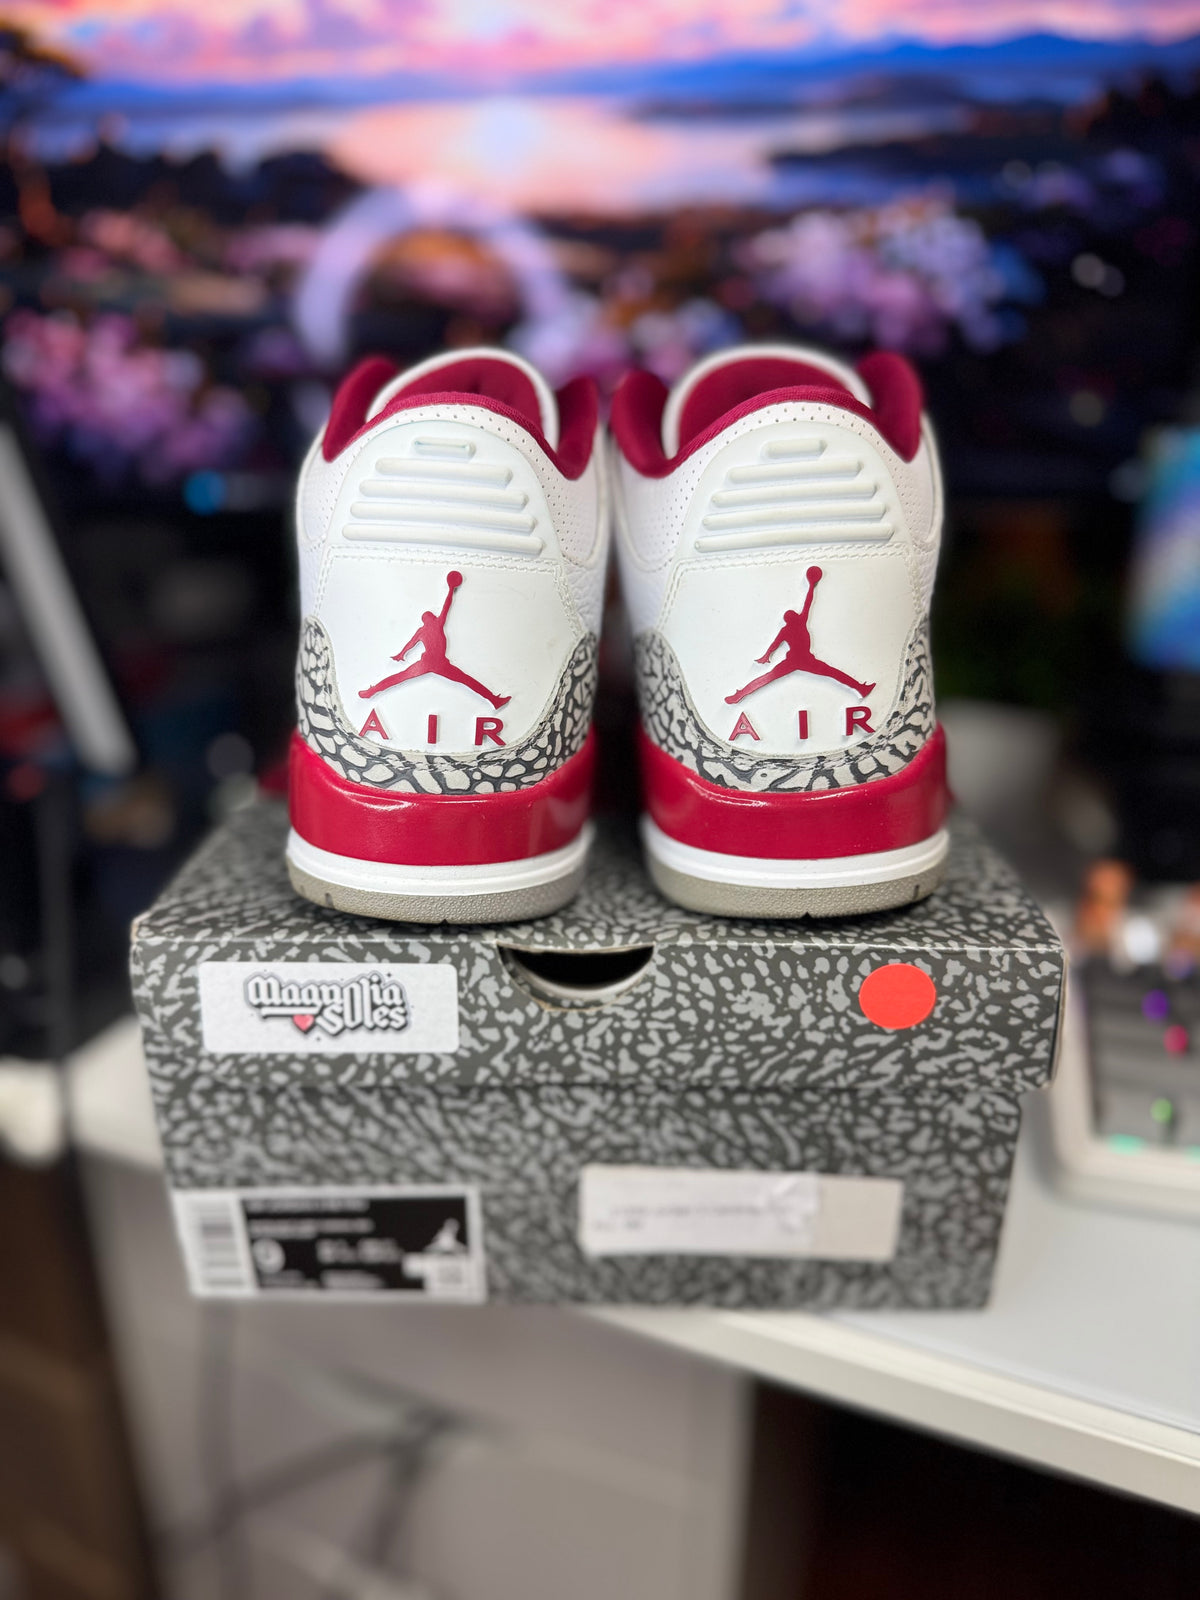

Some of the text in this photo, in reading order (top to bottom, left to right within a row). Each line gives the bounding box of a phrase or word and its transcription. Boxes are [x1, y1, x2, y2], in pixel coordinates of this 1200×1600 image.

[359, 708, 506, 746] AIR
[728, 706, 876, 741] AIR
[246, 973, 405, 1018] Magnolia
